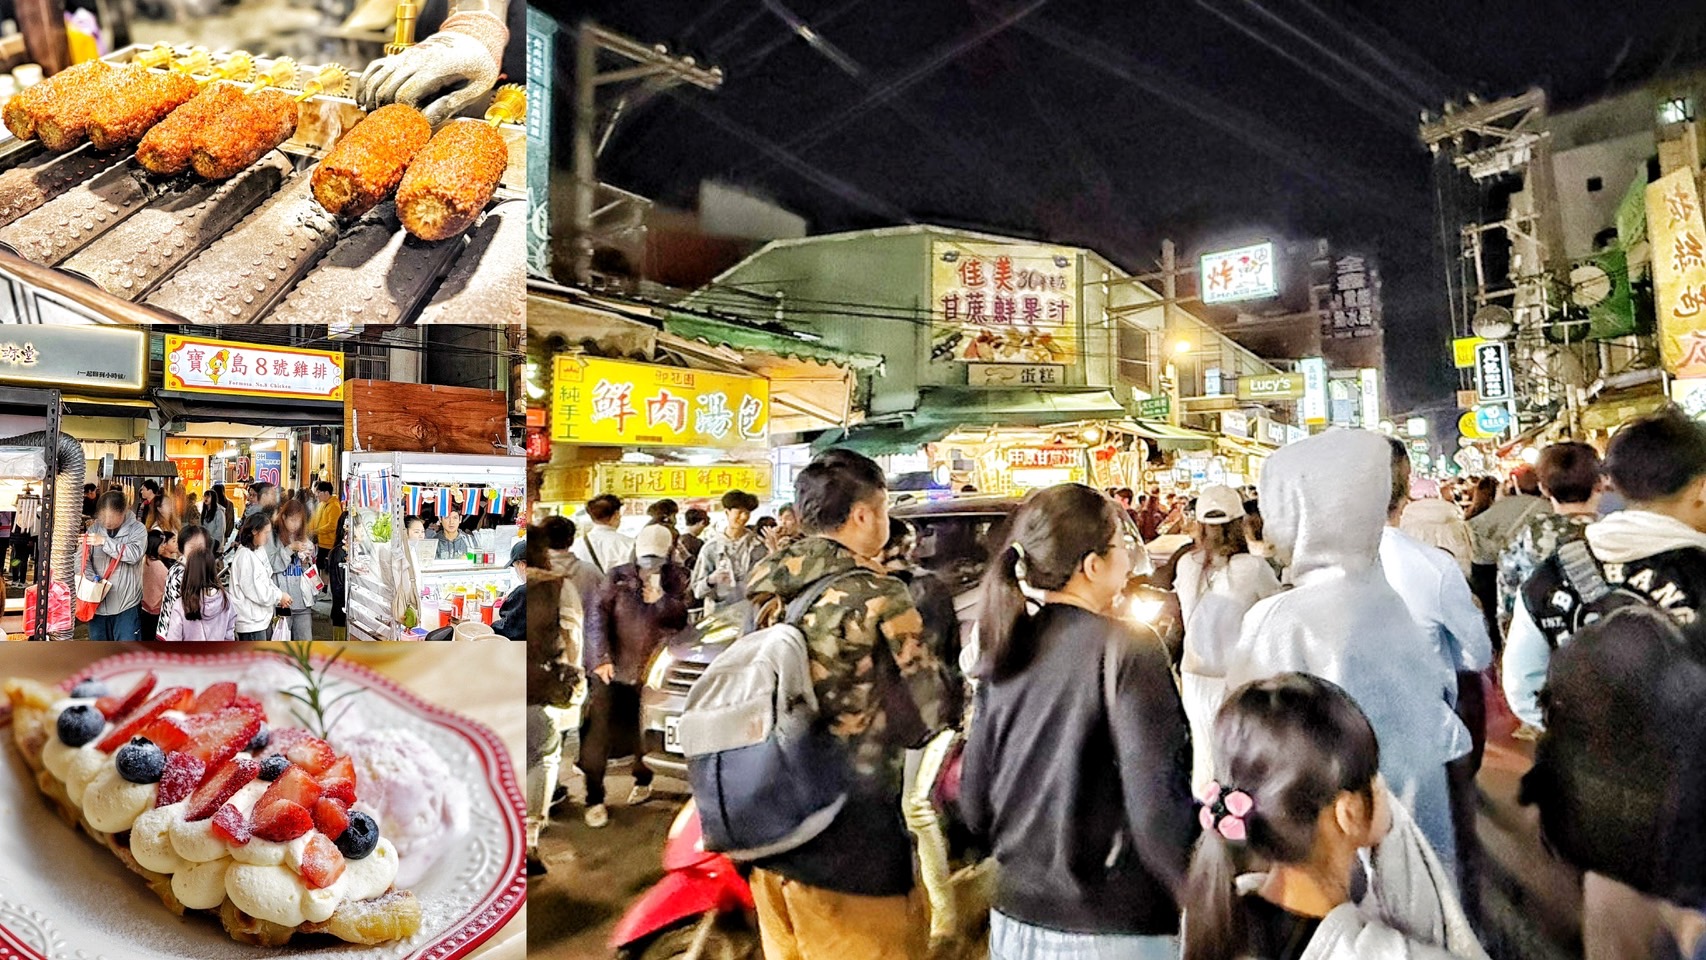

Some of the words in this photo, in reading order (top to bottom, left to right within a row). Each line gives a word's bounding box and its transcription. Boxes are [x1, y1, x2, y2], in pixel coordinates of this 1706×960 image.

[958, 255, 1014, 292] 佳美
[941, 292, 1070, 325] 甘蔗鮮果汁
[186, 349, 328, 380] 寶島8號雞排
[1021, 368, 1056, 384] 蛋糕
[1250, 377, 1291, 393] Lucy's
[558, 386, 580, 440] 純手工
[591, 380, 768, 440] 鮮肉湯包
[258, 467, 280, 489] 50
[622, 471, 687, 492] 御冠園
[697, 470, 768, 490] 鮮肉湯包
